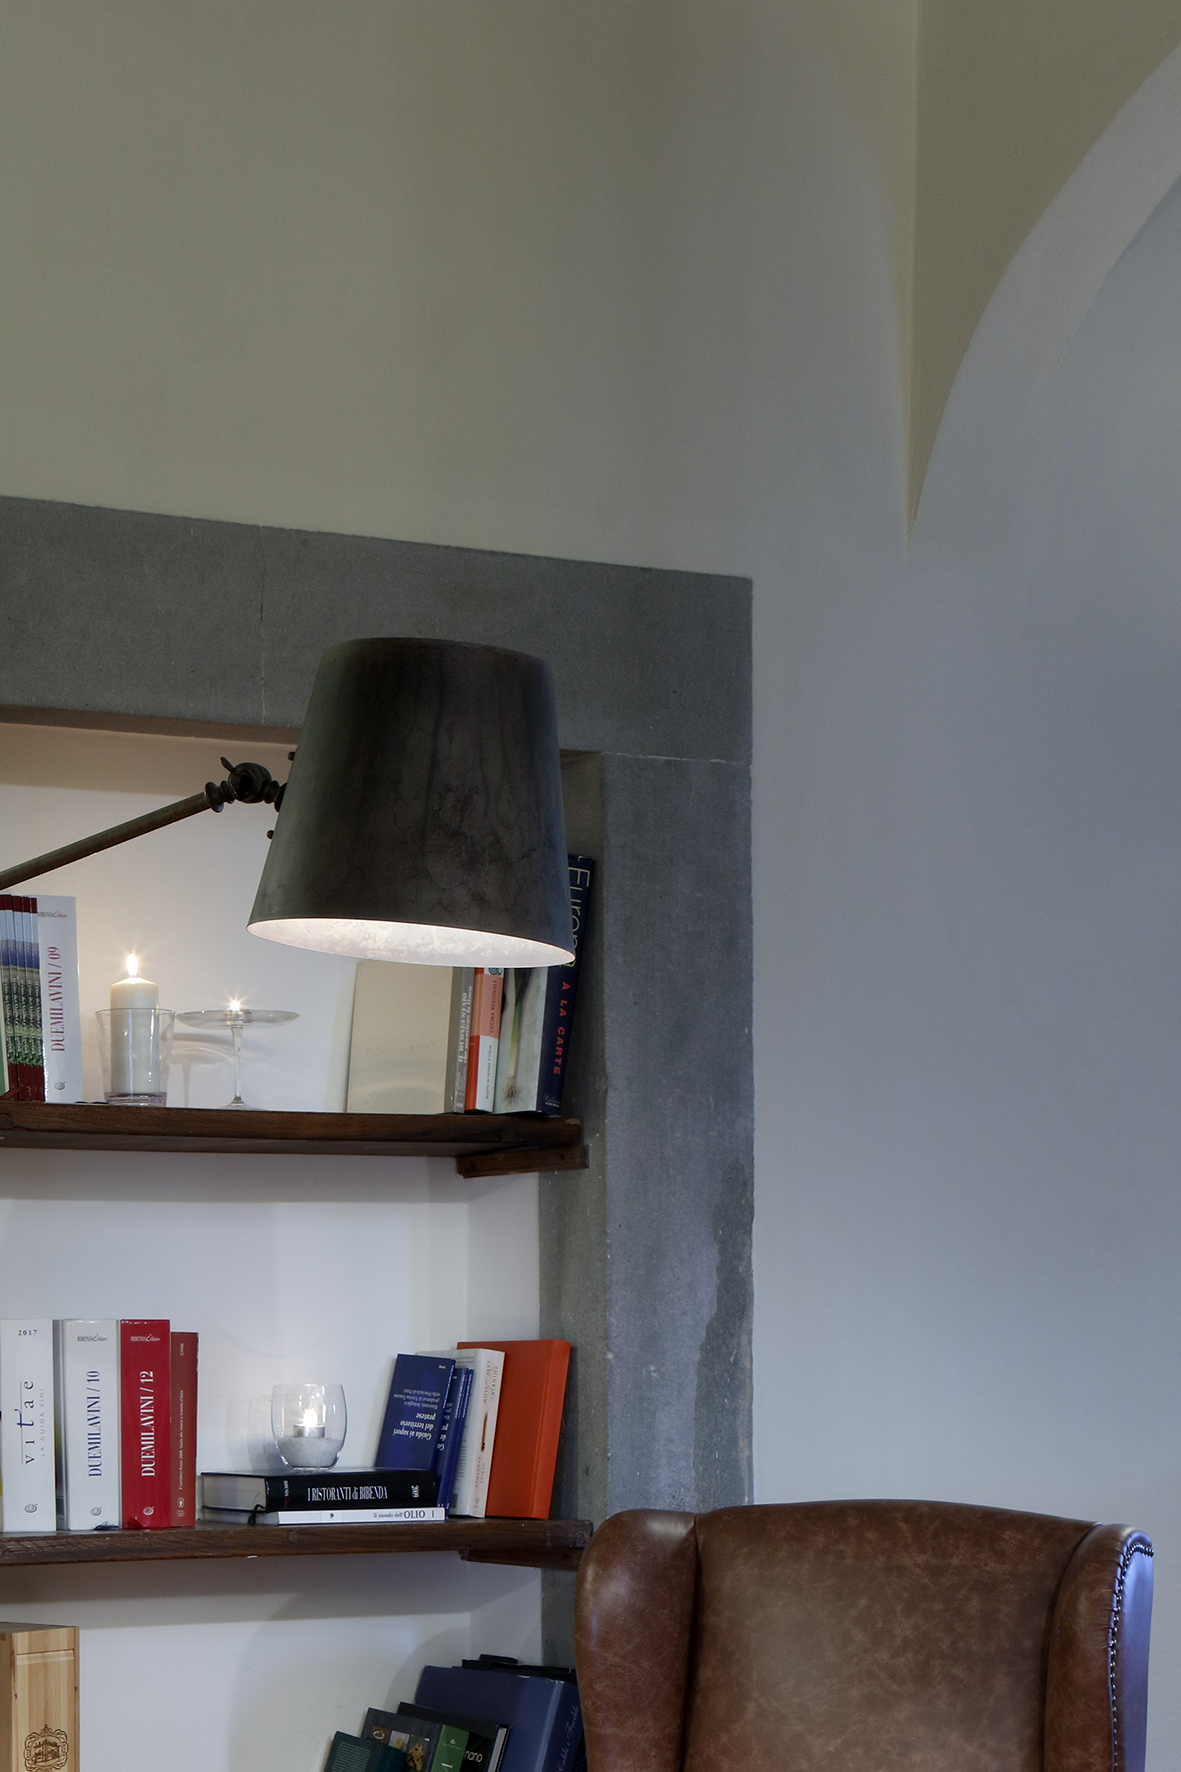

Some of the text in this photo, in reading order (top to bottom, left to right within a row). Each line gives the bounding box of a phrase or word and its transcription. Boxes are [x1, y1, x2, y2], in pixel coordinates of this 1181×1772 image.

[47, 946, 61, 960] 09
[48, 972, 65, 1051] DUEMILAVINI
[559, 1000, 568, 1017] LA
[553, 1026, 565, 1075] CARTE
[86, 1370, 100, 1384] 10
[139, 1370, 154, 1384] 12
[14, 1380, 35, 1465] vitae
[415, 1413, 437, 1421] pratese
[392, 1427, 410, 1437] sapori
[399, 1420, 434, 1431] del territorio
[88, 1395, 102, 1478] DUEMILAVINI
[141, 1395, 155, 1478] DUEMILAVINI
[415, 1431, 432, 1441] Guida
[40, 1448, 46, 1457] LA
[311, 1486, 352, 1502] RISTORANTI
[352, 1486, 359, 1500] di
[359, 1485, 388, 1500] BIBENDA
